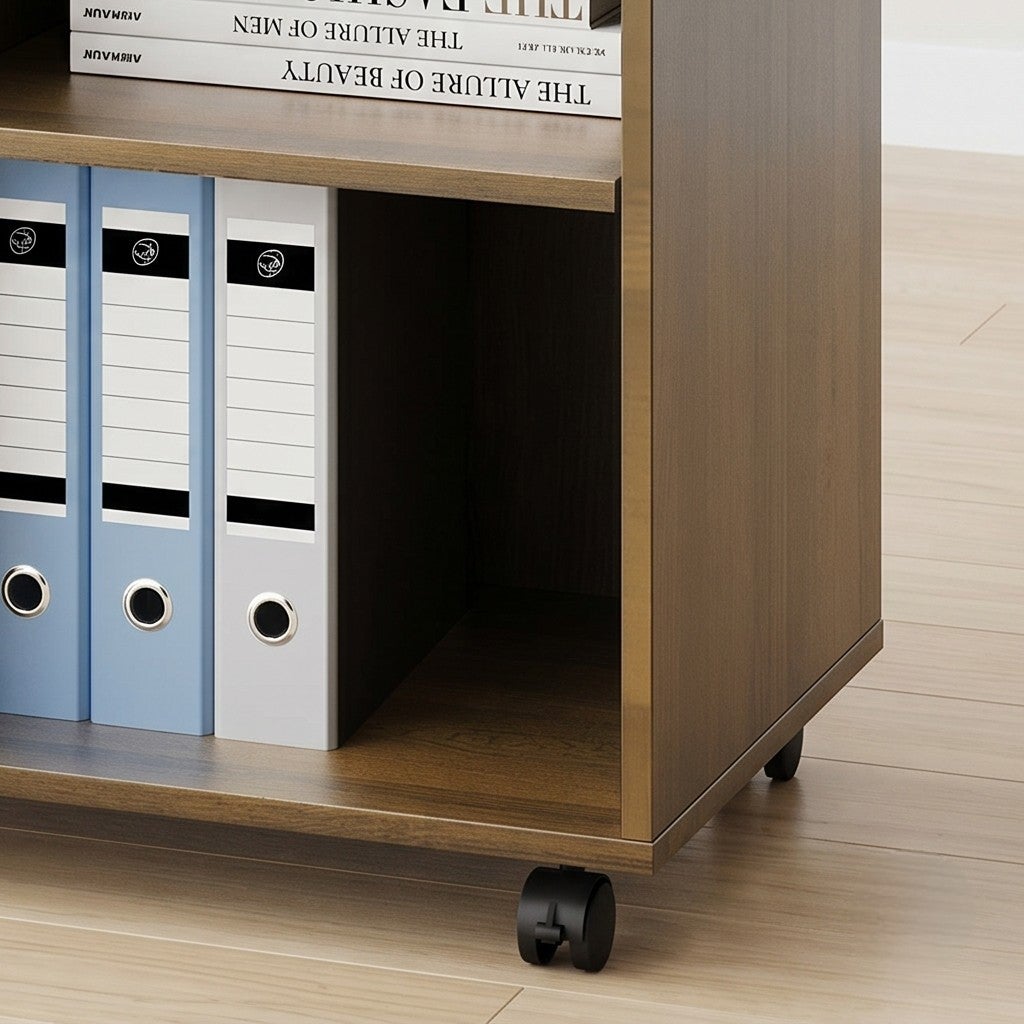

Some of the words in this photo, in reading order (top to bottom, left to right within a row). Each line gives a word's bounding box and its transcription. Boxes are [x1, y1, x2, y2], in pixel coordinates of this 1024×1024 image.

[232, 14, 285, 37] MEN
[288, 18, 318, 39] OF
[324, 21, 412, 46] ALLURE
[416, 29, 464, 50] THE
[280, 59, 384, 88] BEAUTY
[390, 68, 424, 91] OF
[431, 71, 532, 101] ALLURE
[537, 80, 593, 106] THE
